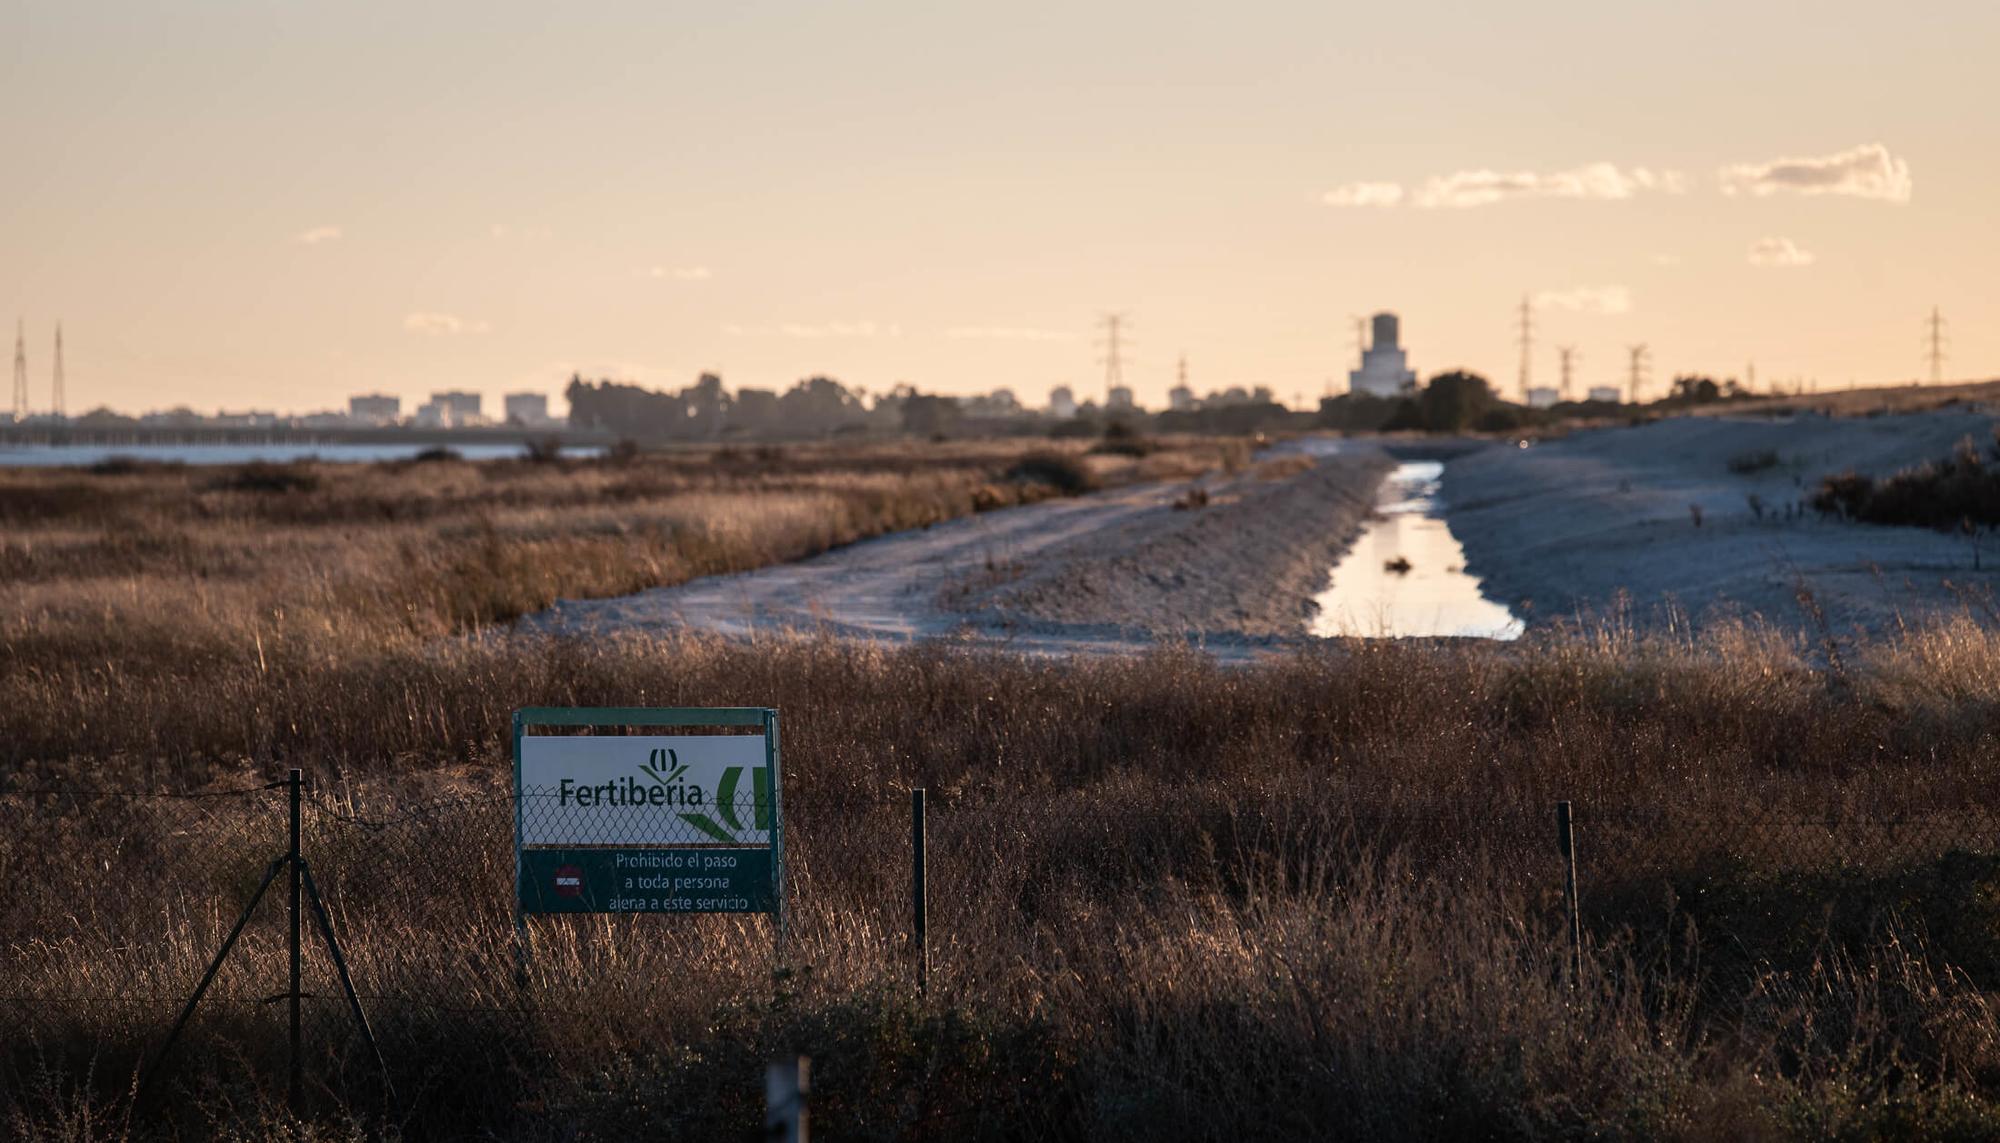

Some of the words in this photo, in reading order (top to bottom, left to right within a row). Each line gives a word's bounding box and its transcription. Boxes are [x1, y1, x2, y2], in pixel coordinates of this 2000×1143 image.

[560, 776, 703, 807] Fertiberia
[686, 853, 699, 868] el
[704, 856, 737, 871] paso
[625, 878, 633, 889] a
[638, 873, 670, 889] toda
[674, 878, 730, 892] persona
[651, 898, 659, 910] a
[663, 896, 692, 910] este
[696, 894, 748, 910] servicio
